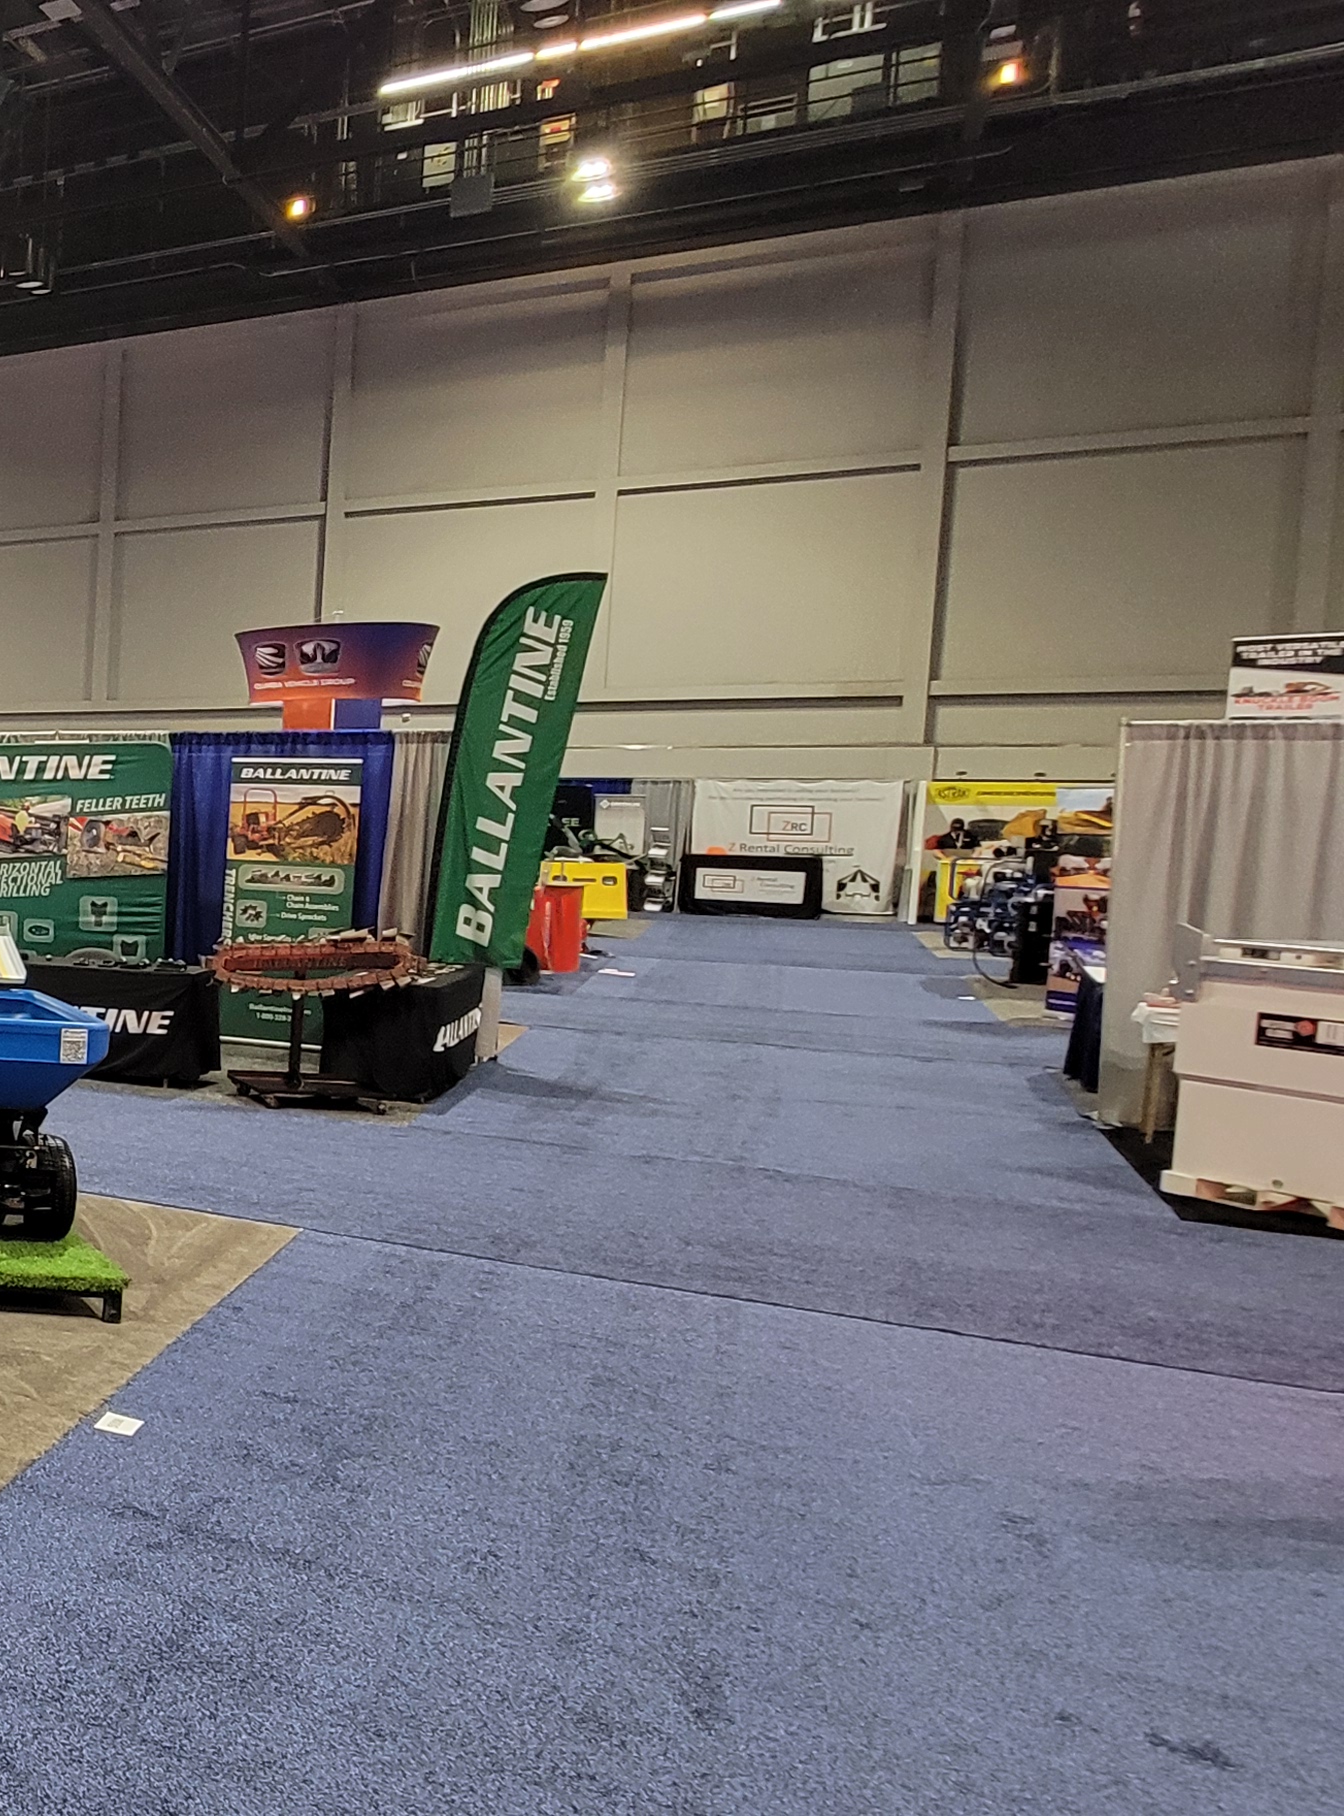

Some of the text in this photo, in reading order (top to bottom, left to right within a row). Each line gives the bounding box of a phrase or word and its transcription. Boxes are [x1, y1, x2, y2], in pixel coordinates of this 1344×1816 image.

[544, 619, 574, 701] Established 1959
[240, 767, 352, 781] BALLANTINE
[455, 606, 562, 947] BALLANTINE
[75, 793, 166, 813] FELLER TEETH
[782, 820, 807, 832] ZRC
[739, 843, 780, 853] Rental
[784, 844, 854, 856] Consulting
